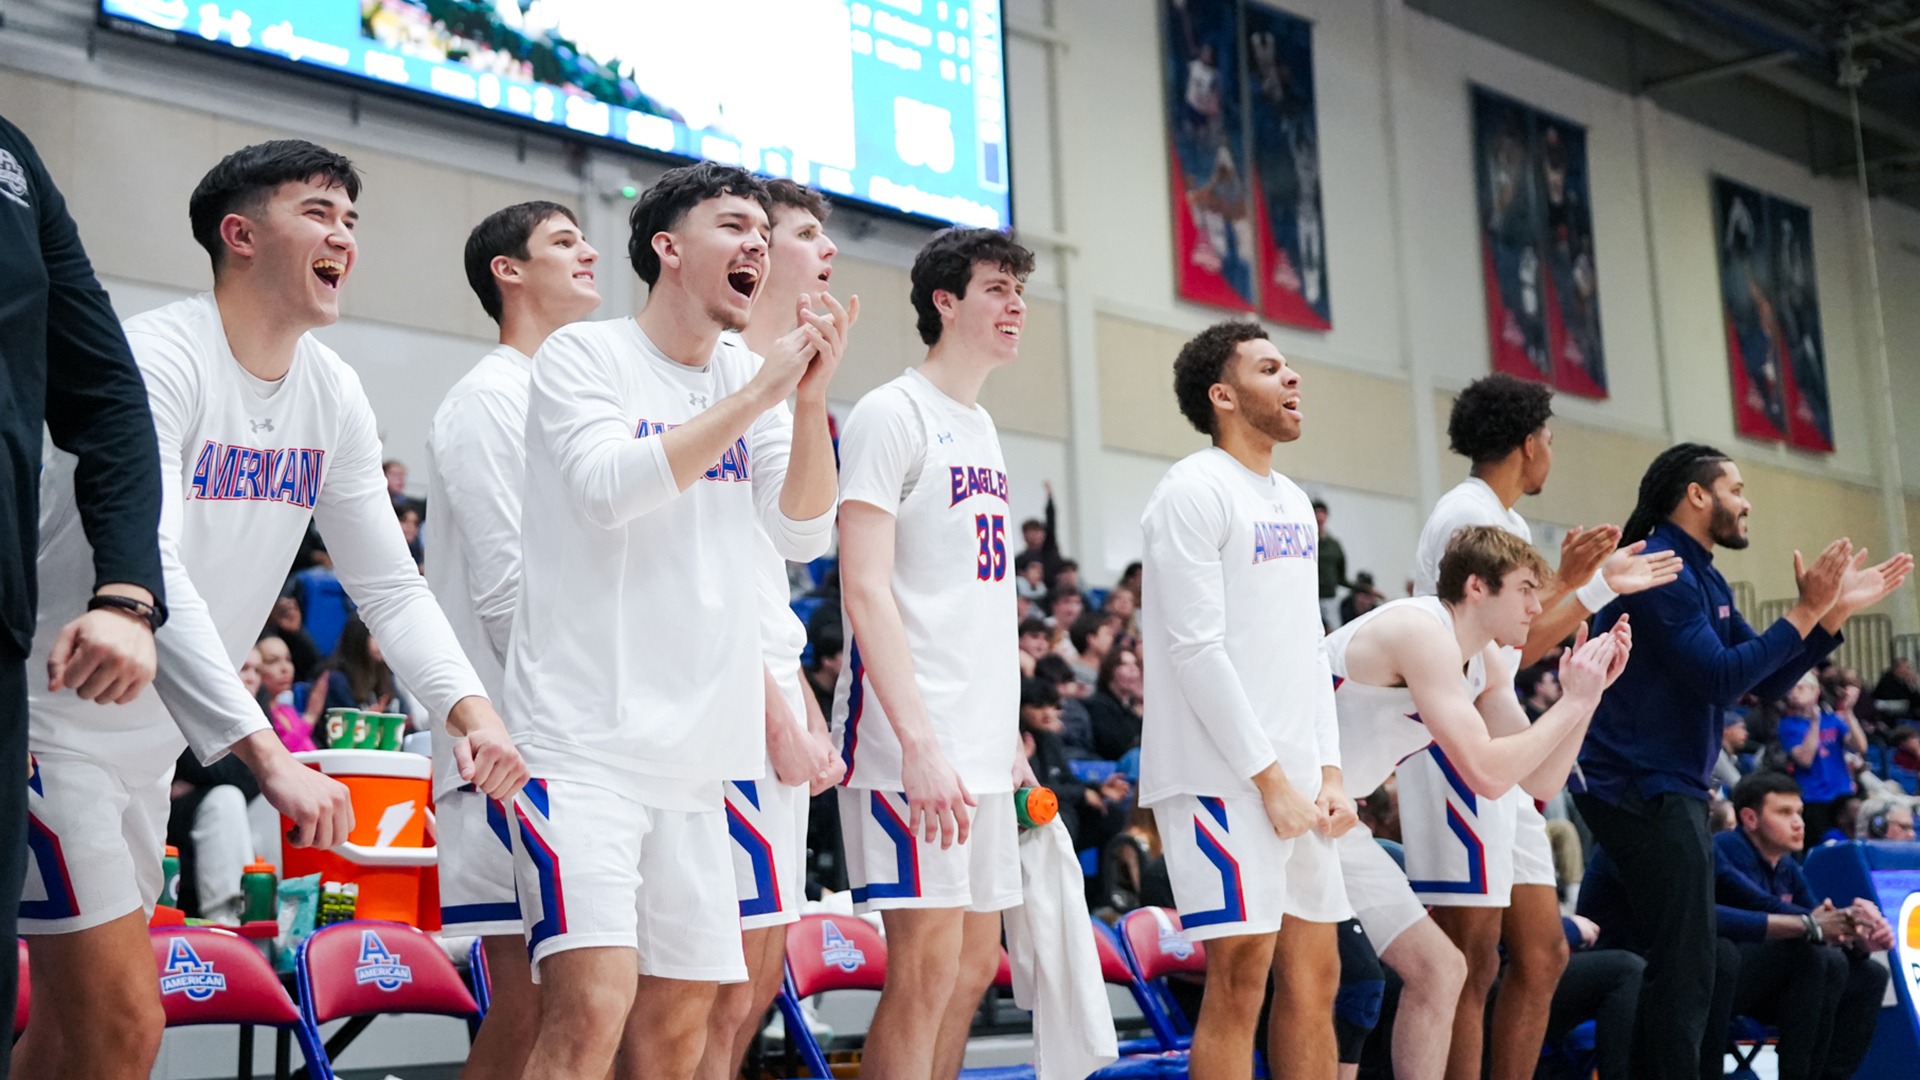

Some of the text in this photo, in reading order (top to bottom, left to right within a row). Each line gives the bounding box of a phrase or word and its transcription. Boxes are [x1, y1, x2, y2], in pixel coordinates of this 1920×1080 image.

[186, 440, 325, 509] AMERICAN
[948, 466, 1009, 508] EAGLE
[975, 513, 1007, 582] 35
[1252, 521, 1318, 565] AMERICA
[164, 974, 222, 991] AMERICAN
[358, 966, 410, 981] AMERICAN
